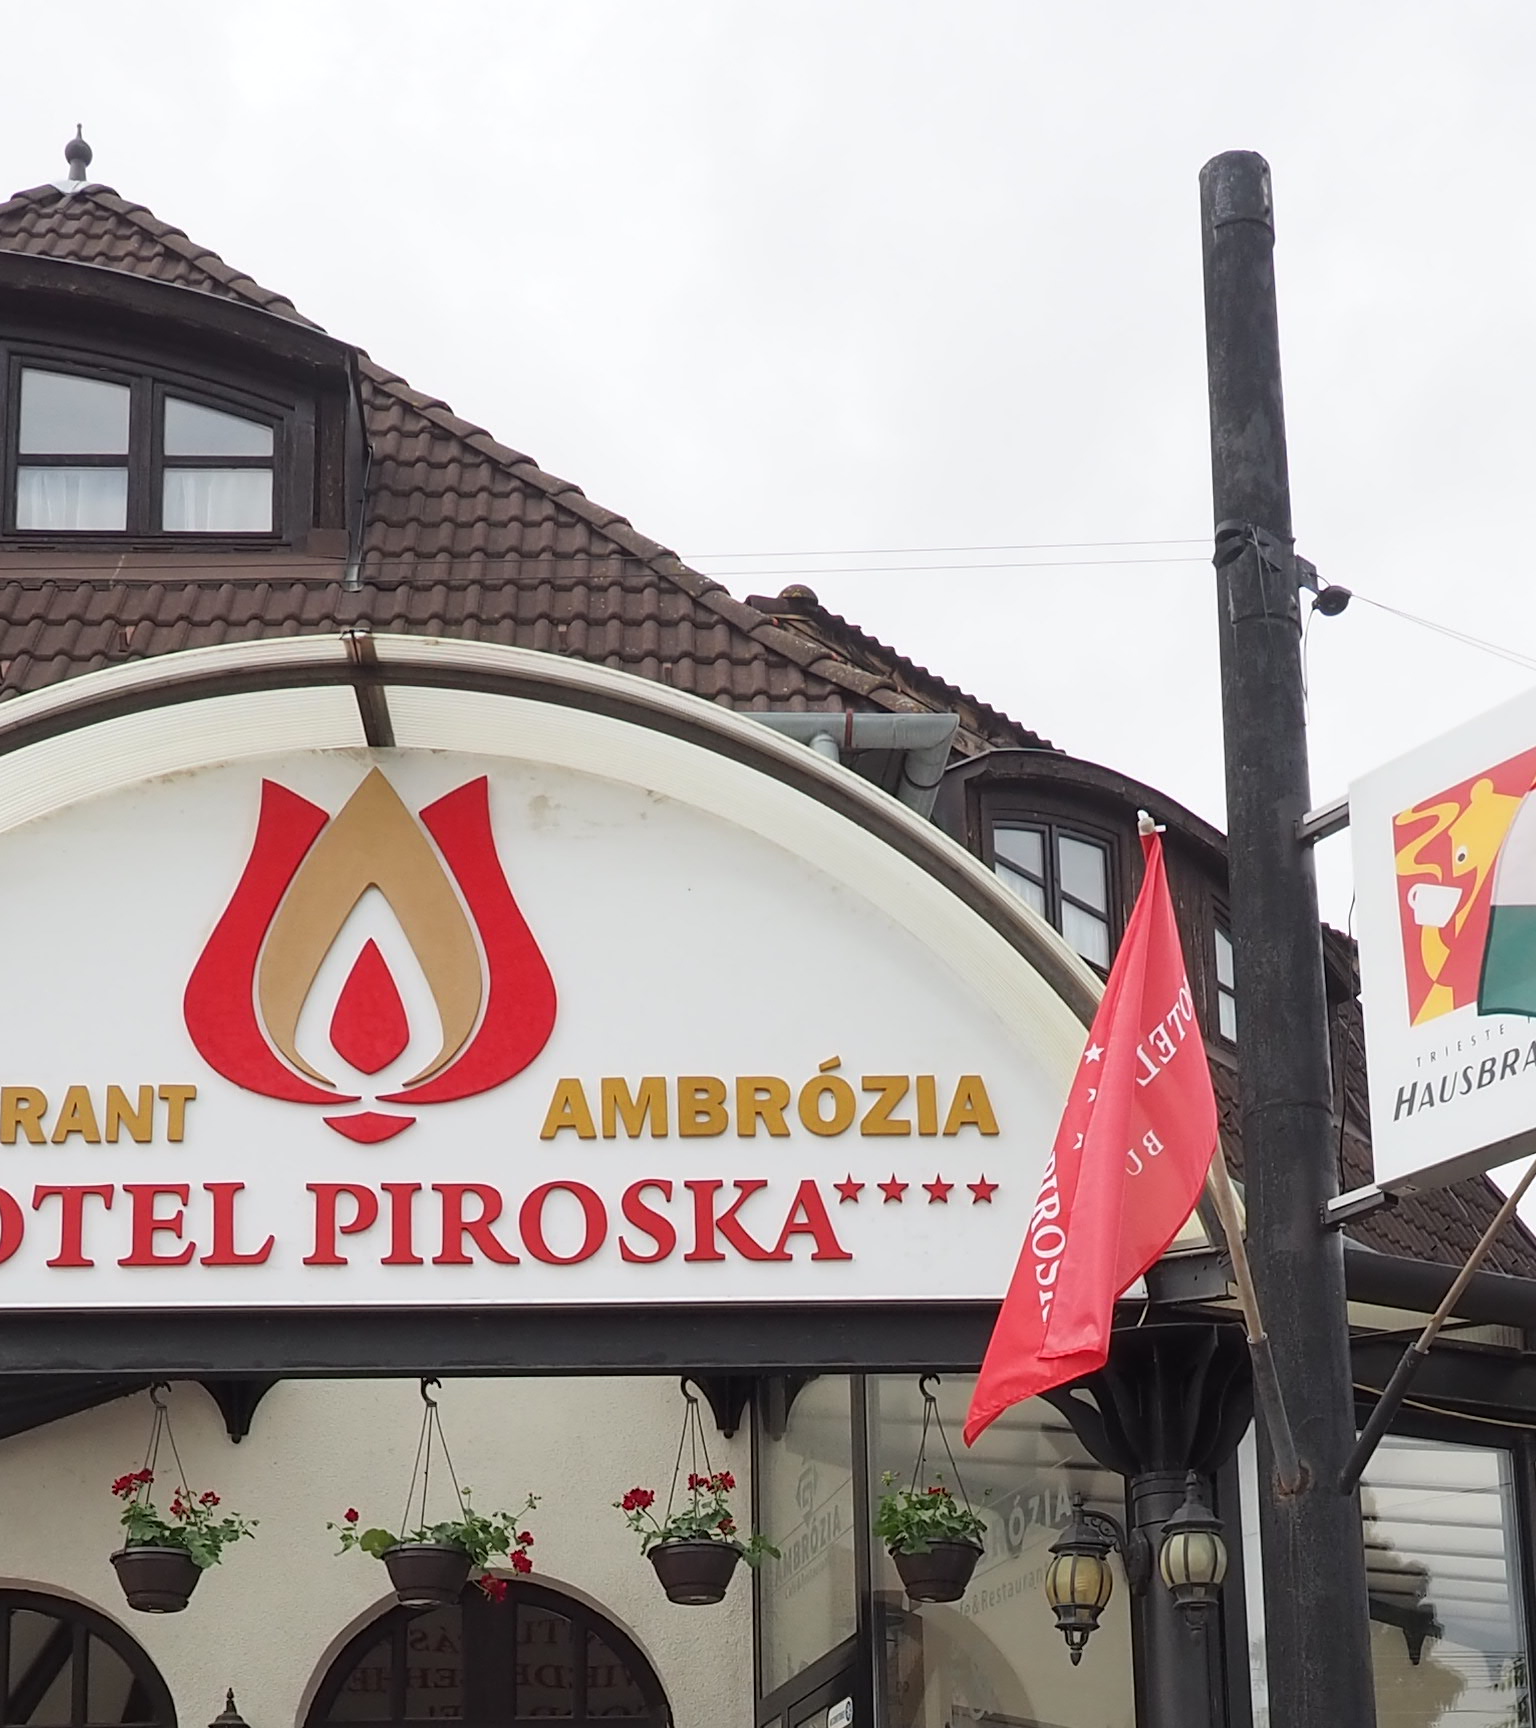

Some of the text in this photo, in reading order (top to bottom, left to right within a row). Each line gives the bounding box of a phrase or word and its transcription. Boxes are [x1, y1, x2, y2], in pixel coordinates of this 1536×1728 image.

[1415, 1024, 1505, 1068] TRIESTE
[539, 1055, 1000, 1141] AMBRÓZIA
[302, 1178, 853, 1266] PIROSKA
